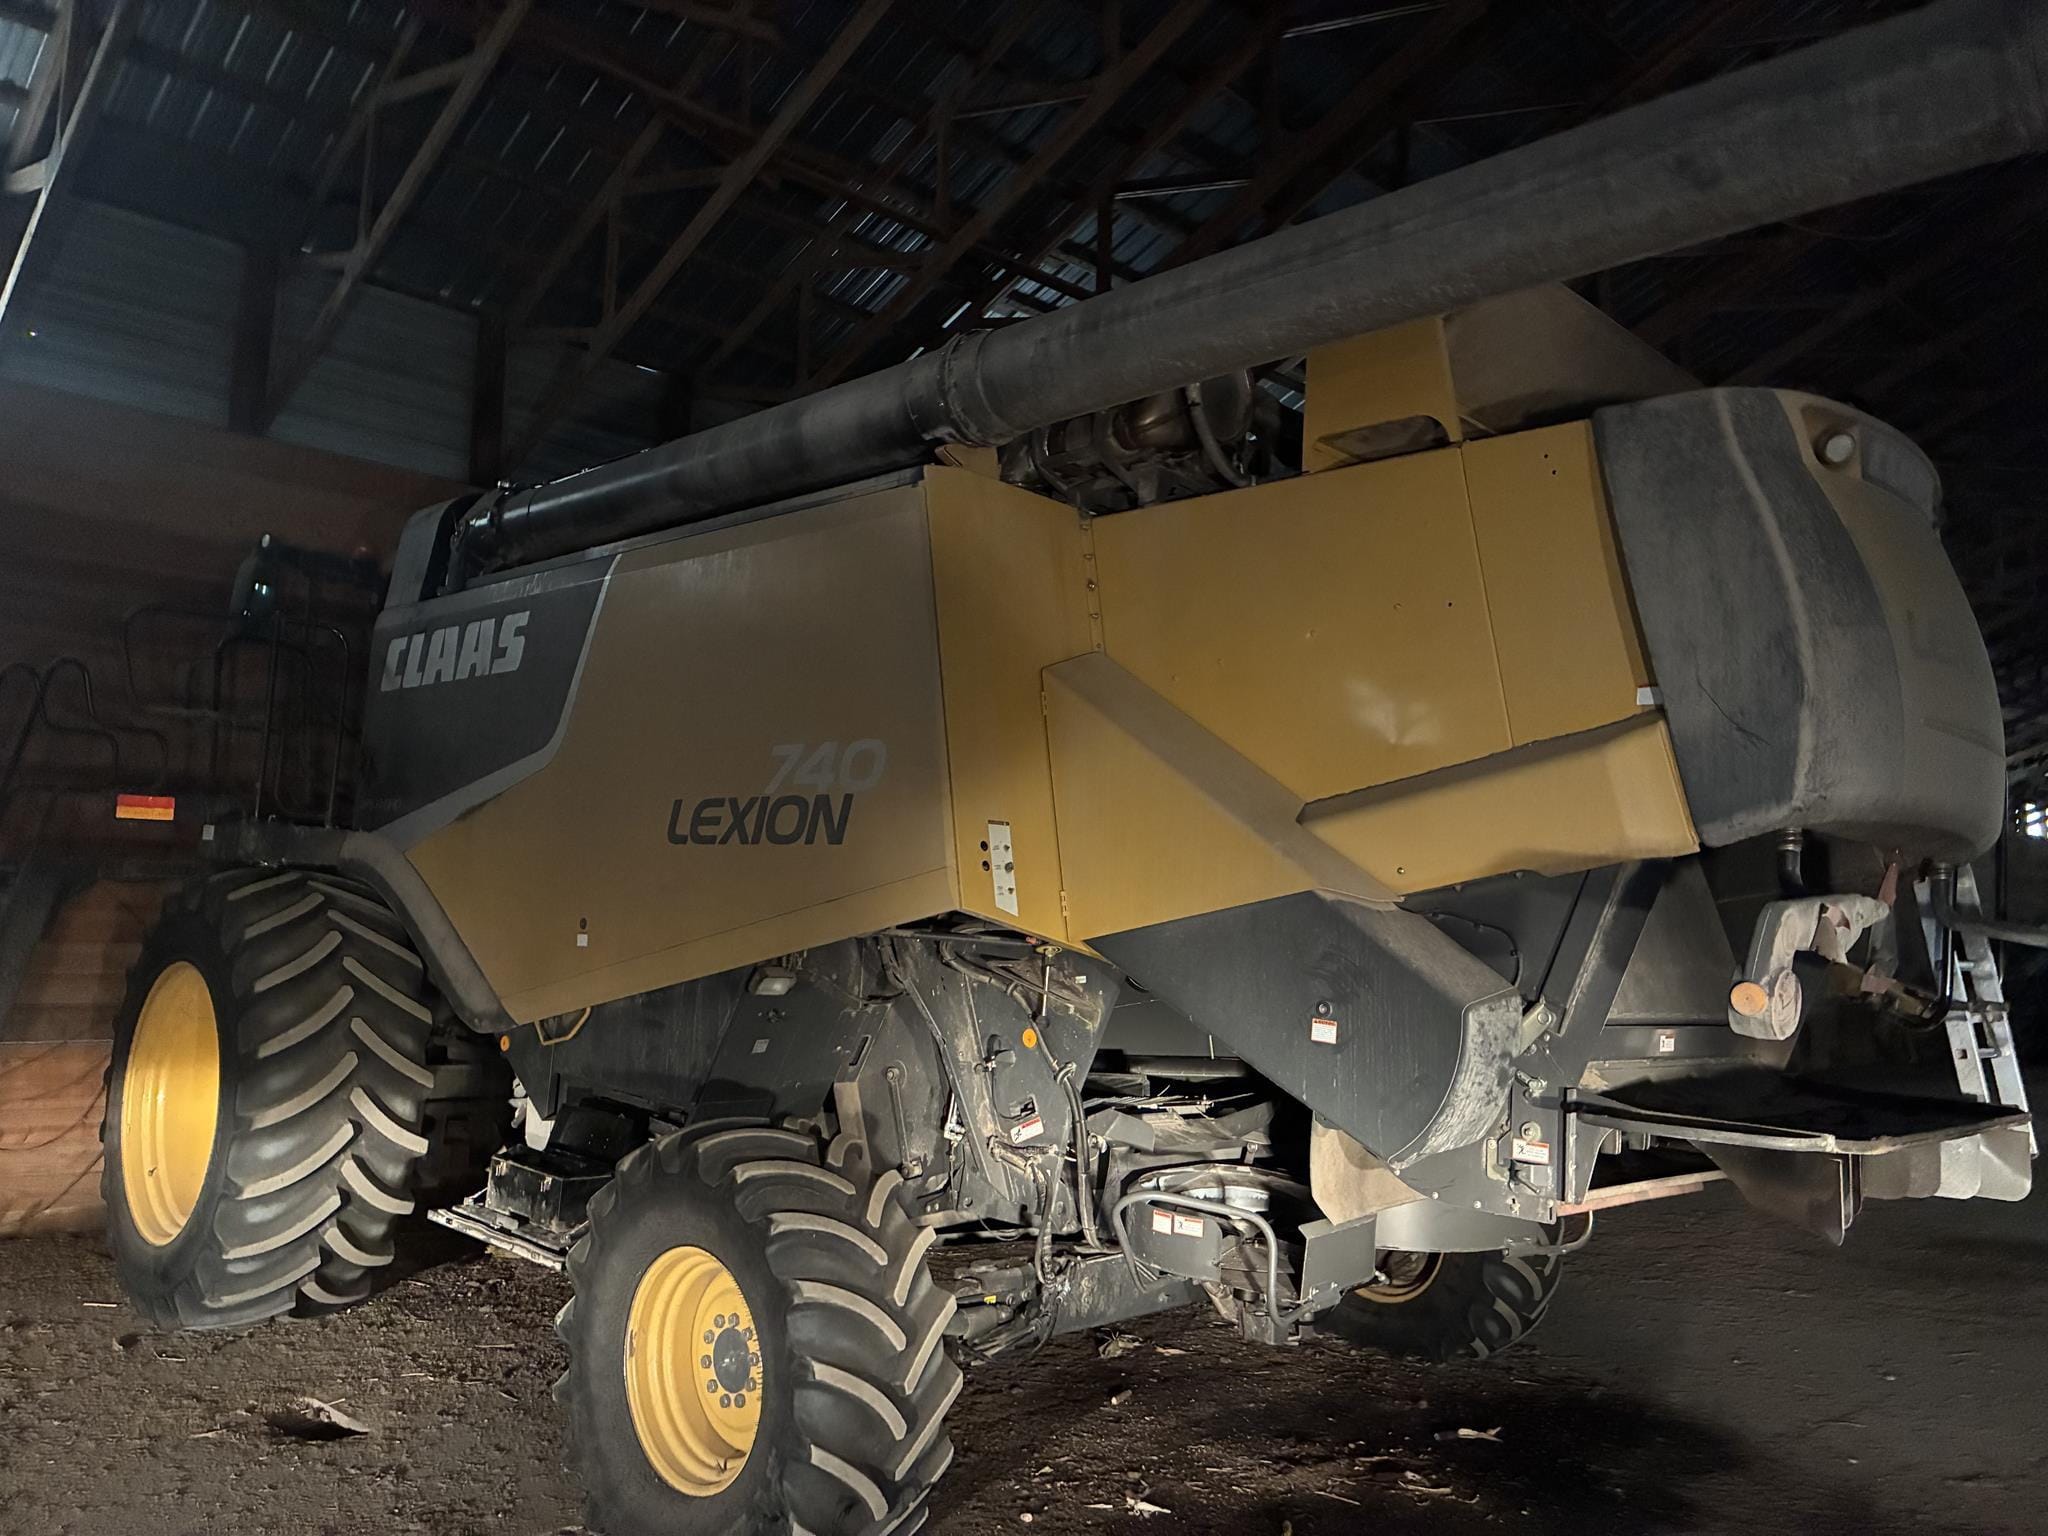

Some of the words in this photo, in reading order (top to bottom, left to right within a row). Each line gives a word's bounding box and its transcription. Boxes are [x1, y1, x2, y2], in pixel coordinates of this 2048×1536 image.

[381, 611, 530, 692] CLAAS
[765, 738, 888, 795] 740
[667, 793, 854, 846] LEXION
